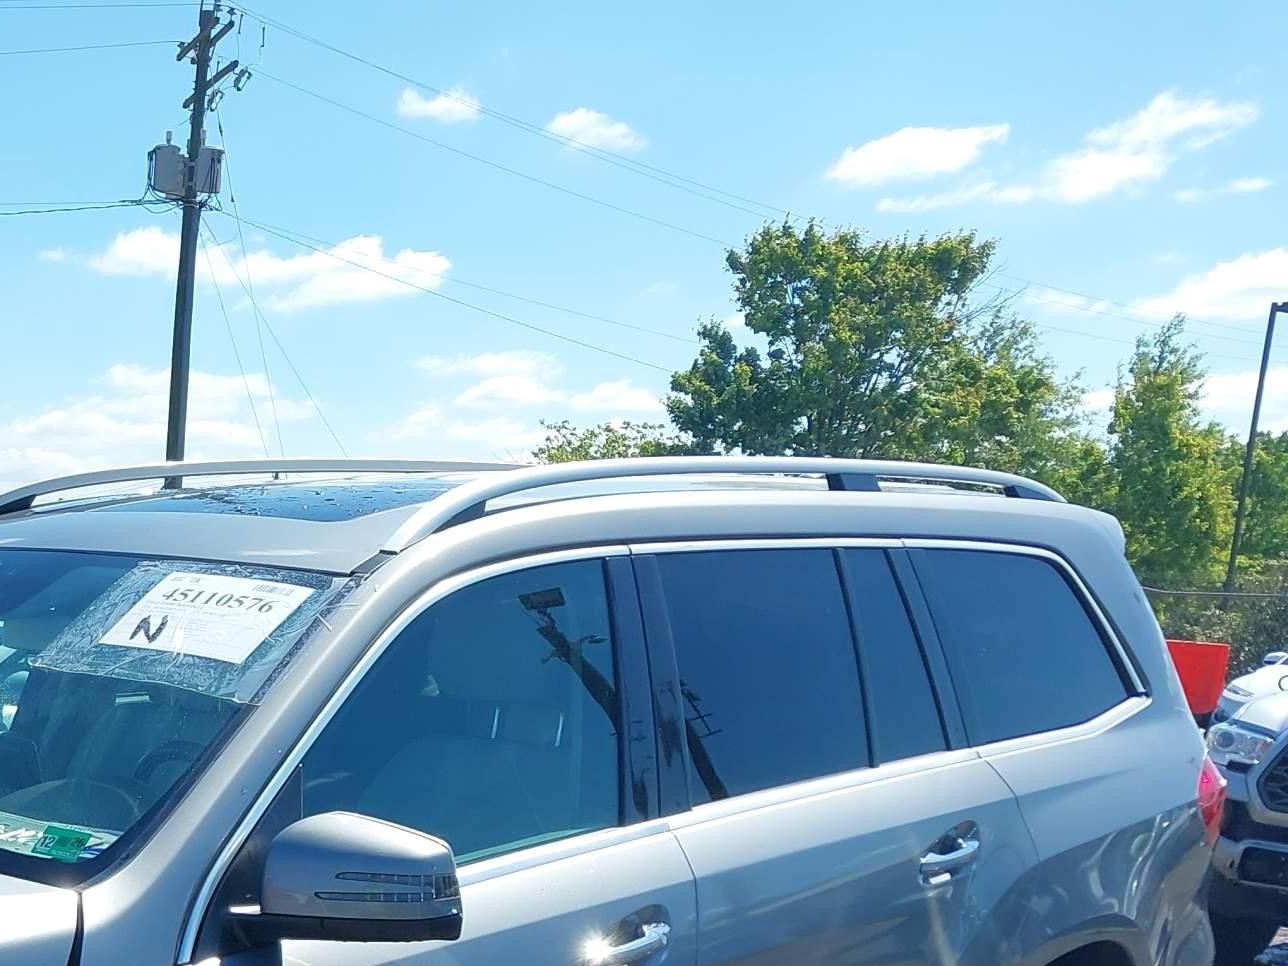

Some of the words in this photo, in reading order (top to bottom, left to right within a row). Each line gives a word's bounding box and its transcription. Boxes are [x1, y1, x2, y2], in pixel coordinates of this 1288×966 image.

[162, 587, 277, 614] 45110576
[128, 614, 169, 644] N
[40, 835, 56, 848] 12
